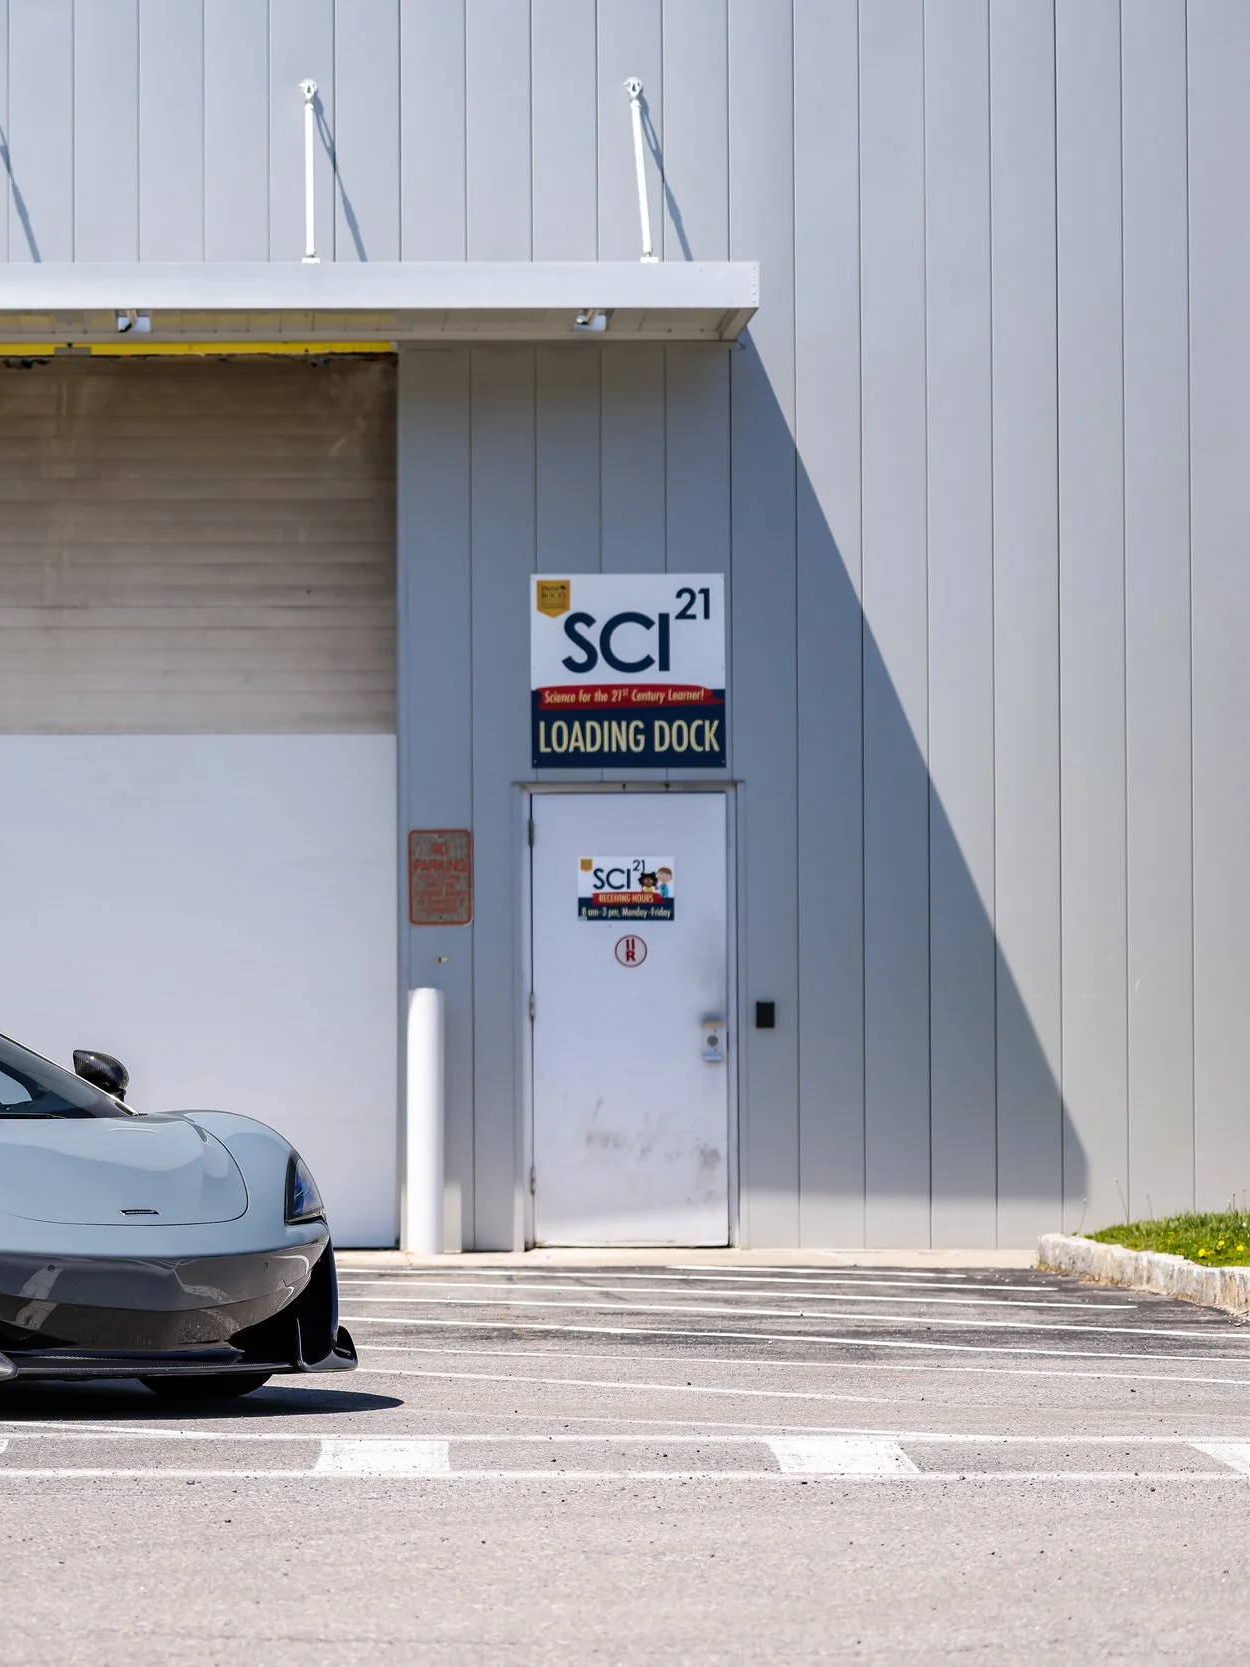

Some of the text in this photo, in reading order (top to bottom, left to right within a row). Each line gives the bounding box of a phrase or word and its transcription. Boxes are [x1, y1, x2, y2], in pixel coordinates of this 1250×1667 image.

[562, 587, 710, 674] SCI 21
[544, 690, 576, 704] Science
[579, 689, 591, 703] for
[594, 690, 608, 702] the
[632, 689, 665, 704] Century
[668, 687, 705, 701] Learner!
[539, 719, 721, 753] LOADING DOCK
[414, 859, 467, 873] PARKING
[593, 867, 631, 890] SCI
[598, 893, 654, 904] RECEIVING HOURS
[625, 950, 636, 962] R
